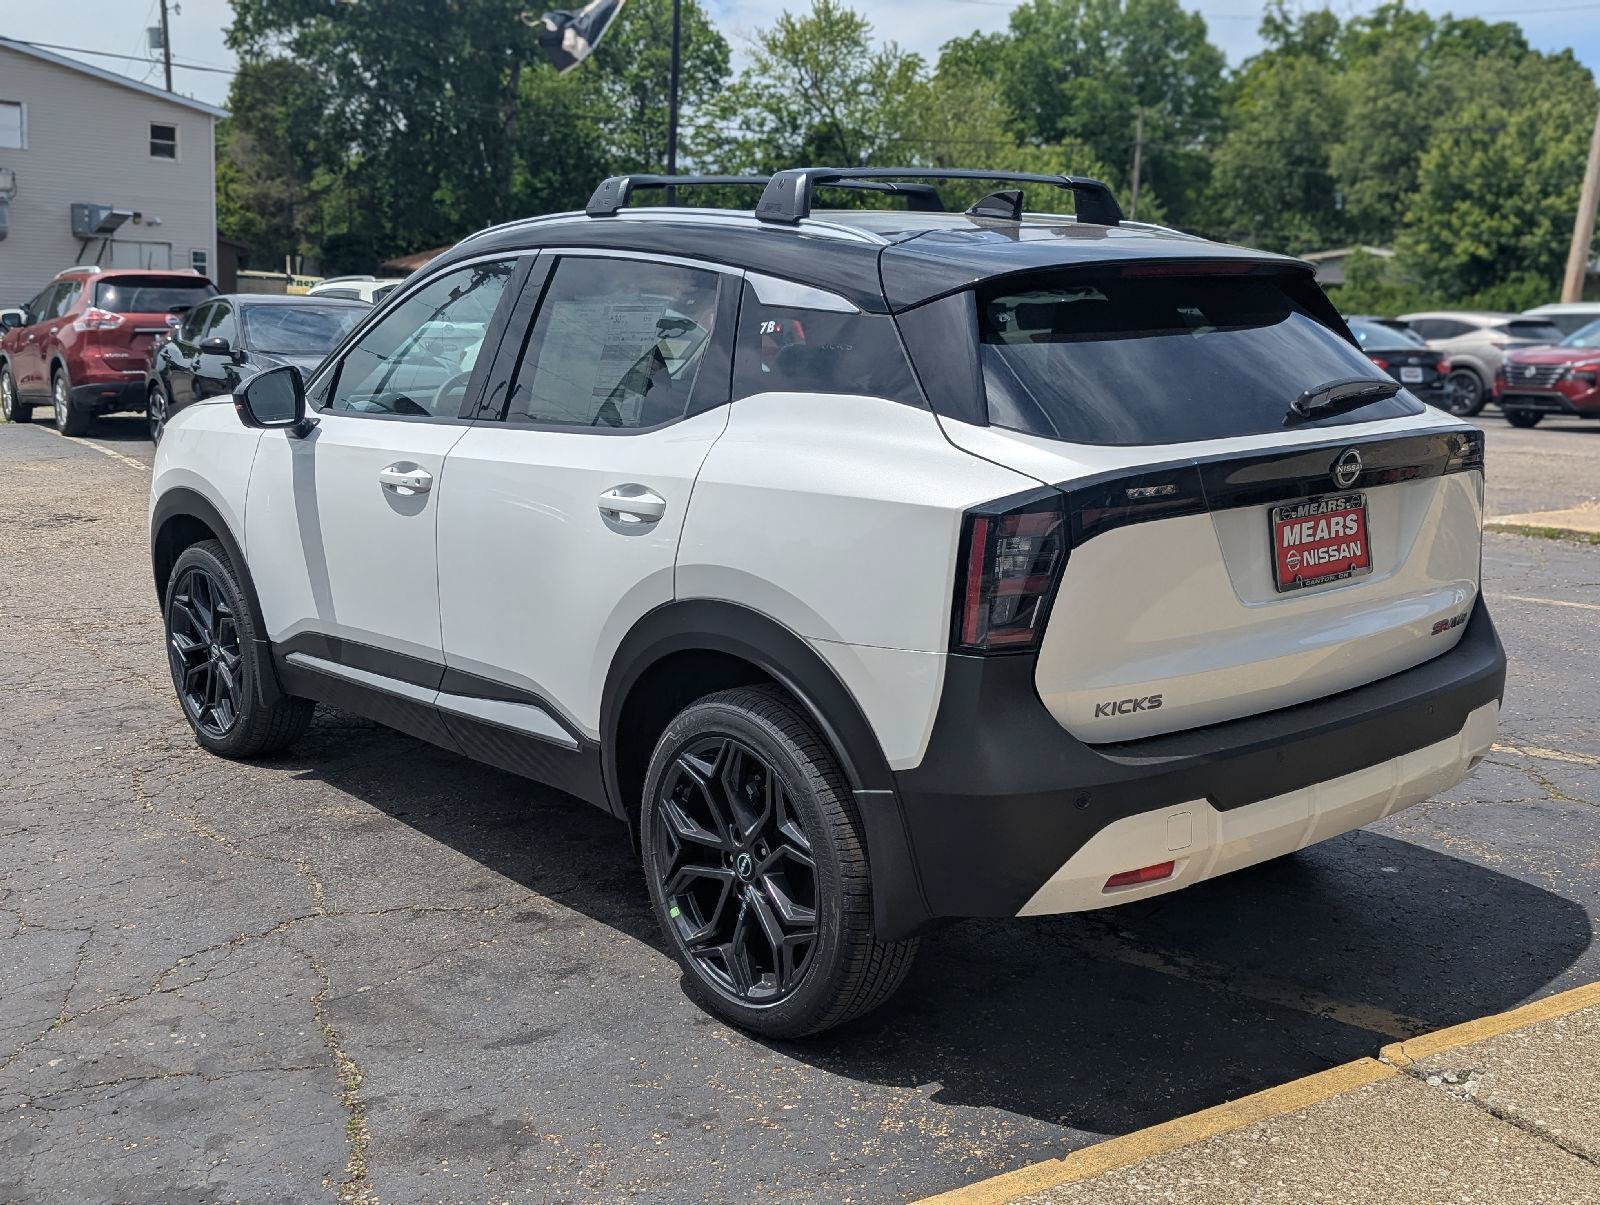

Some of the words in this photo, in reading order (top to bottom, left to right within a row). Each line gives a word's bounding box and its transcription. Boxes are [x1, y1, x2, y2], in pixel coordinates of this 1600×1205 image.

[1297, 498, 1346, 517] MEARS
[1283, 513, 1358, 547] MEARS
[1303, 541, 1362, 566] NISSAN
[1095, 694, 1162, 717] KICKS
